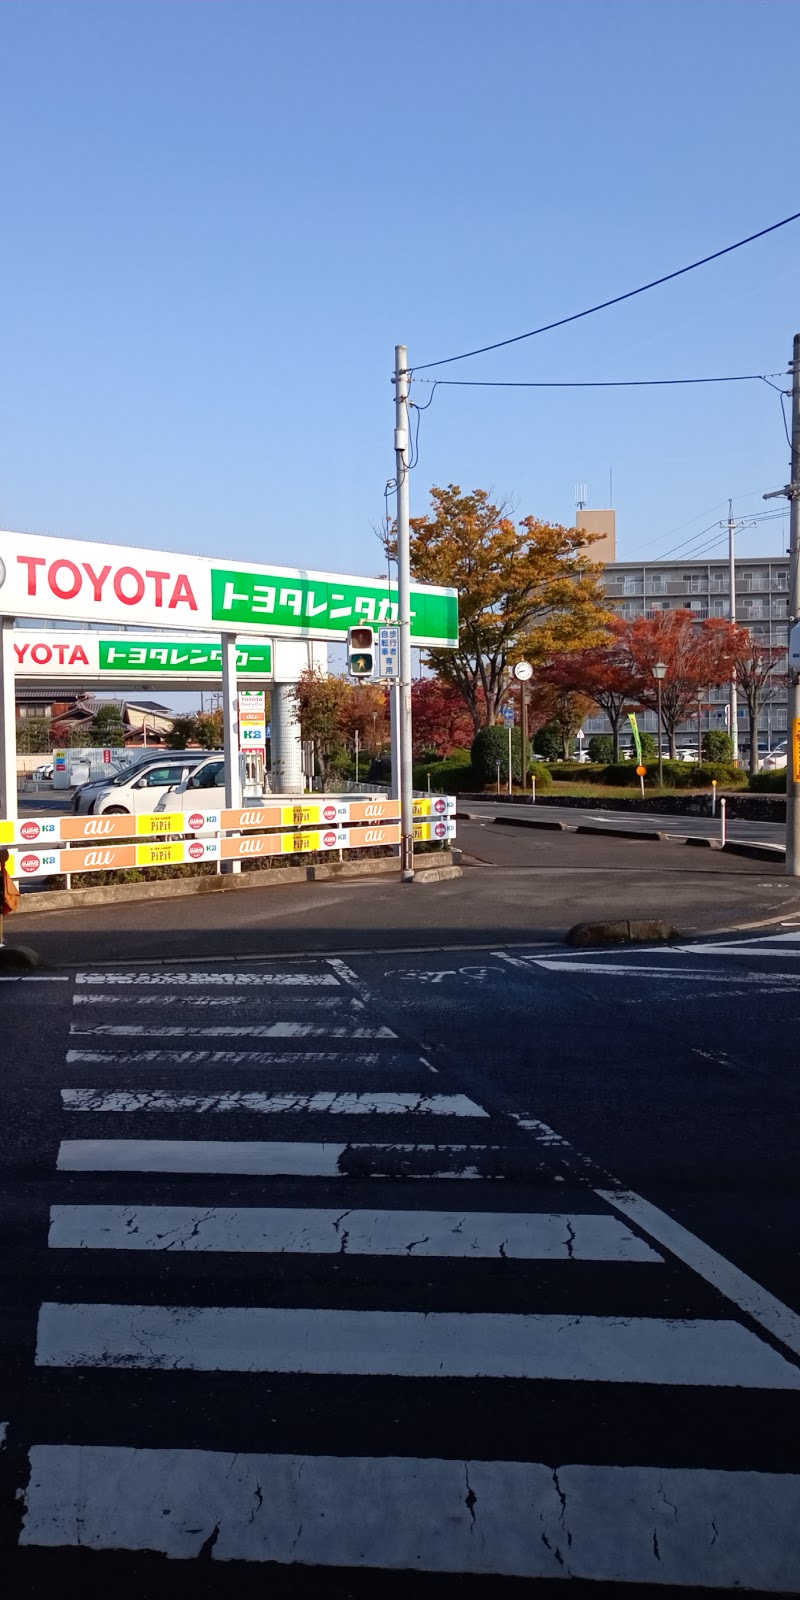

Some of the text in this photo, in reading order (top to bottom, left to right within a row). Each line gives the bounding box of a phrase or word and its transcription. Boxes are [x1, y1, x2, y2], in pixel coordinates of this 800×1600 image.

[17, 555, 198, 611] TOYOTA
[381, 630, 389, 656] 自転車
[389, 630, 397, 656] 歩行者
[107, 647, 264, 667] トヨタレンタカー
[385, 657, 393, 674] 専用
[293, 812, 309, 822] PiPit
[364, 804, 386, 817] au
[239, 811, 265, 825] au
[83, 820, 115, 835] au
[151, 821, 171, 831] PiPit
[364, 831, 386, 842] au
[239, 839, 265, 853] au
[293, 839, 309, 849] PiPit
[83, 851, 115, 866] au
[151, 851, 171, 861] PiPit
